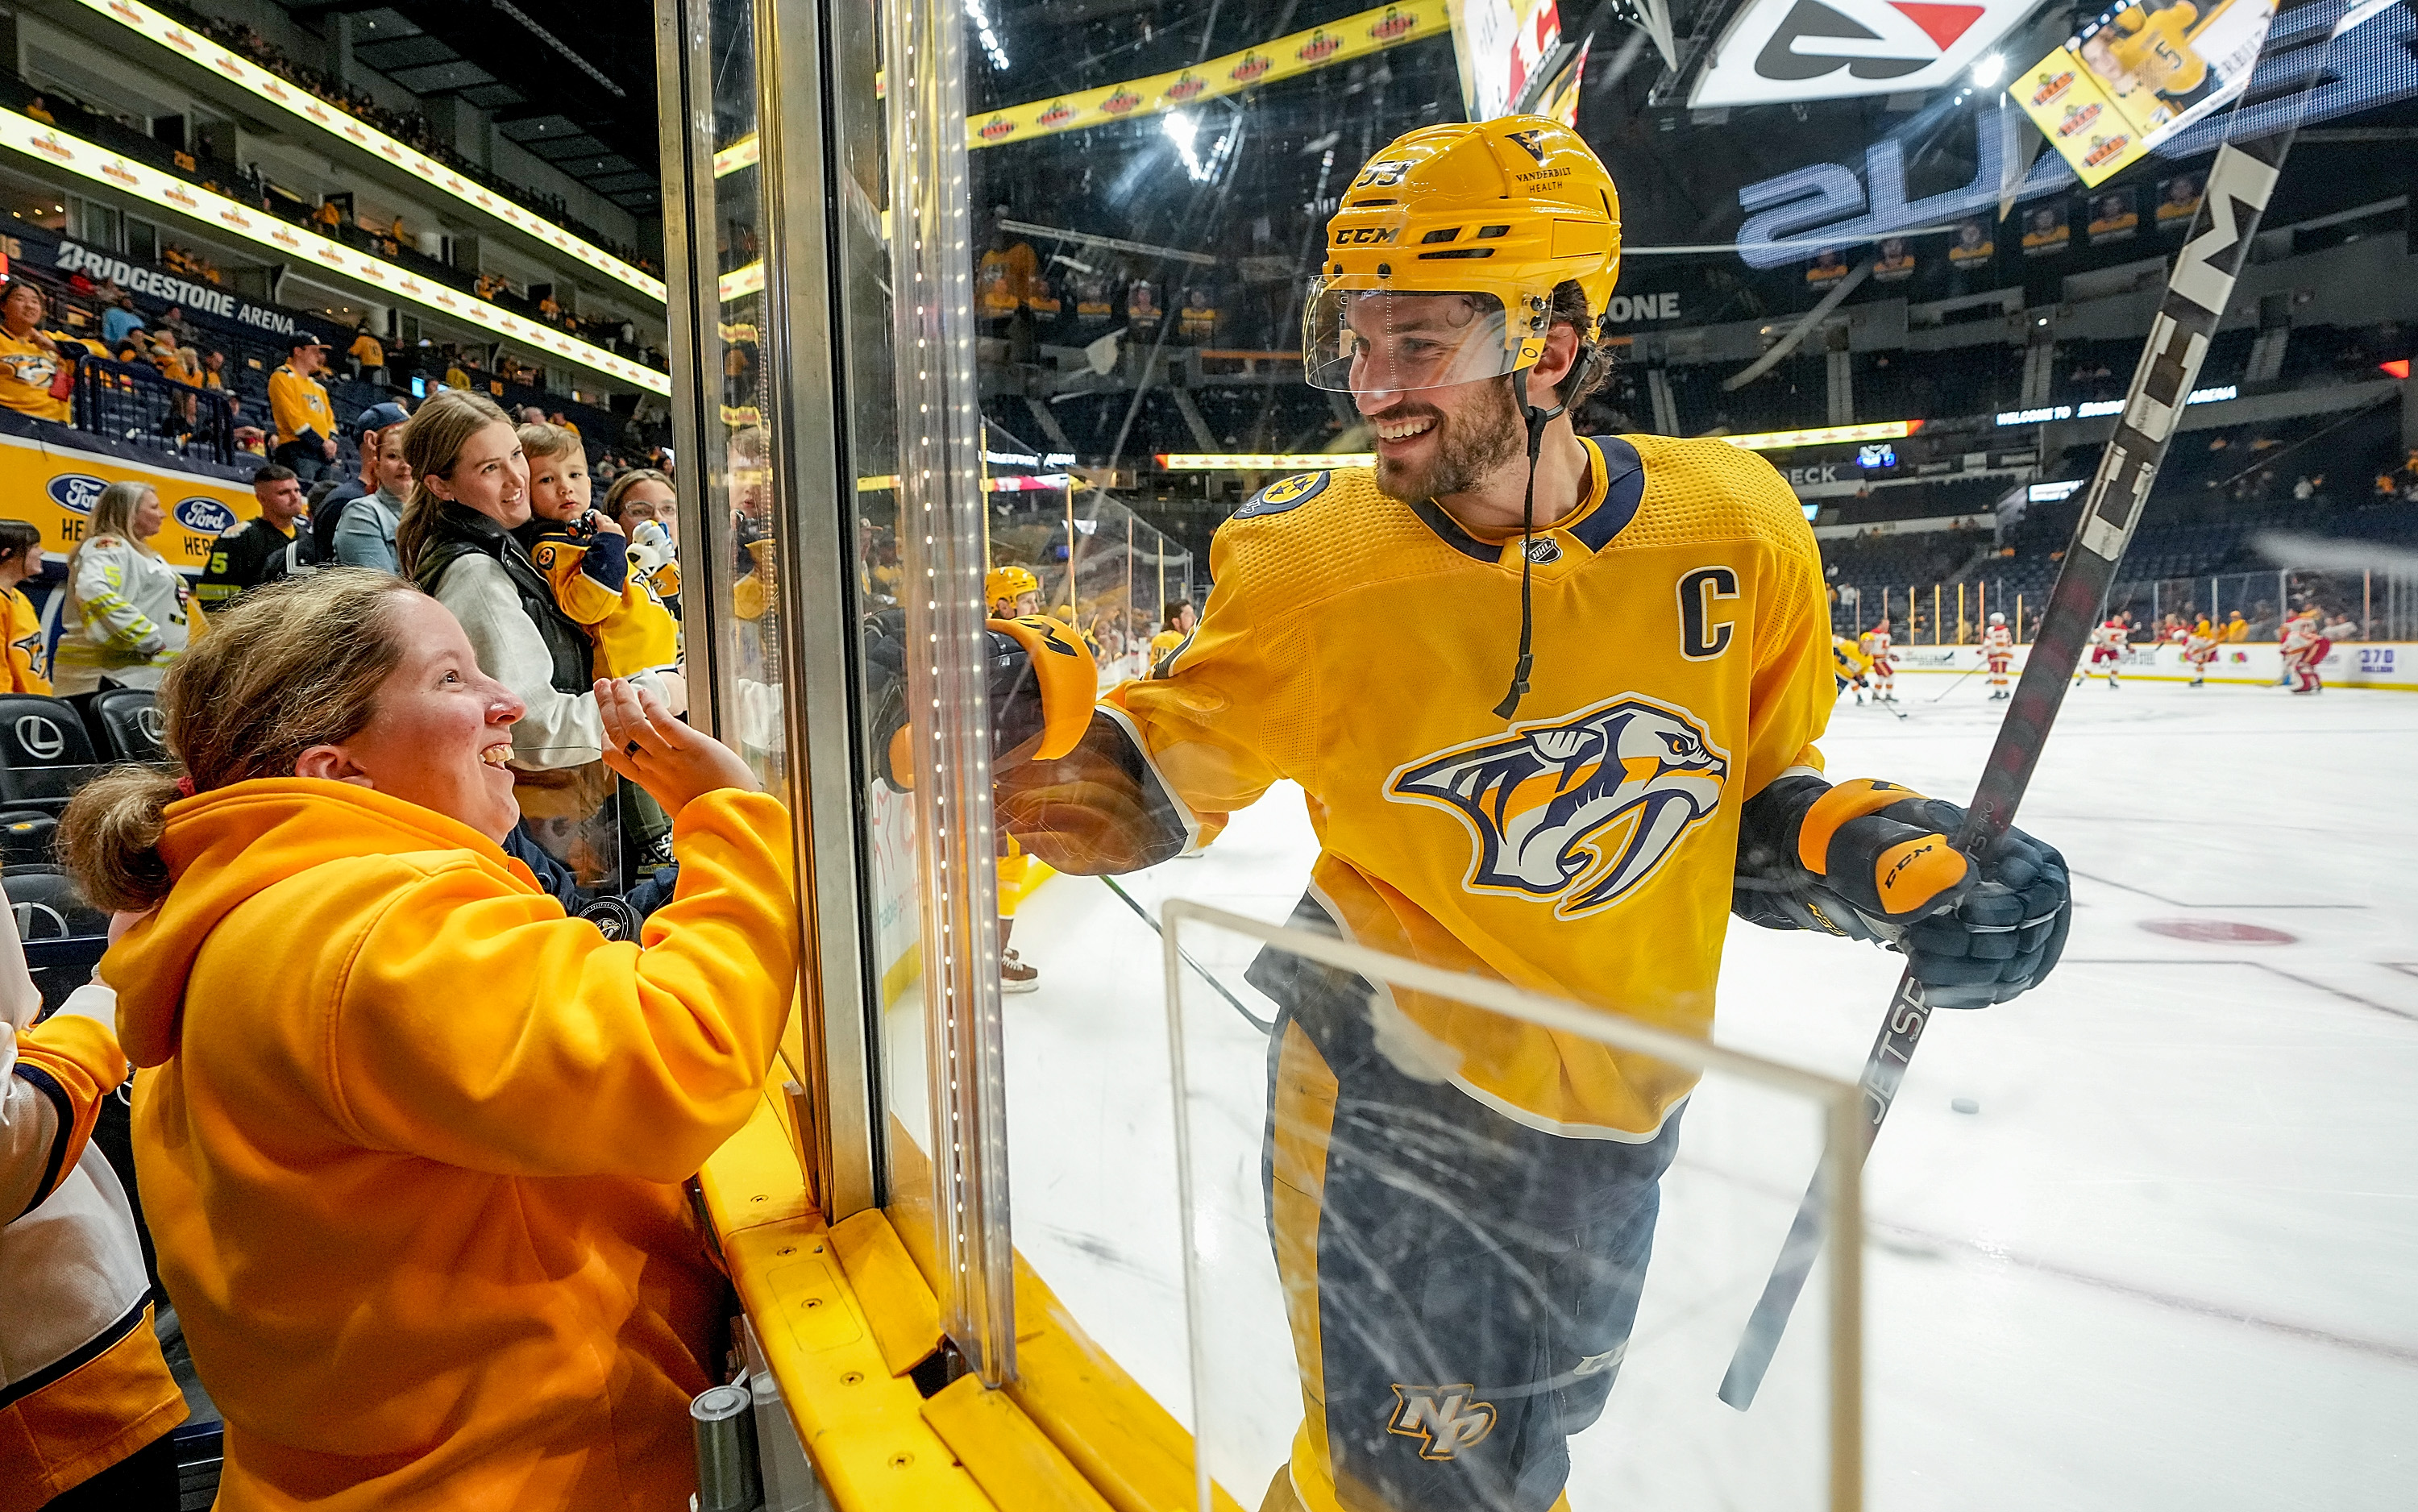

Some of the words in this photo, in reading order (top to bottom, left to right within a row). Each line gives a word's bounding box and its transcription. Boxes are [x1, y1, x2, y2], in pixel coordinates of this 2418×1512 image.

[1516, 167, 1572, 182] VANDERBILT
[1529, 181, 1563, 193] HEALTH
[1335, 228, 1401, 244] CCM
[56, 241, 236, 318] BRIDGESTONE
[238, 303, 295, 336] ARENA
[185, 501, 226, 530] Ford
[1533, 542, 1552, 559] NHL
[210, 552, 230, 575] 5
[103, 566, 123, 588] 5
[1676, 565, 1740, 662] C
[1884, 845, 1933, 889] CCM
